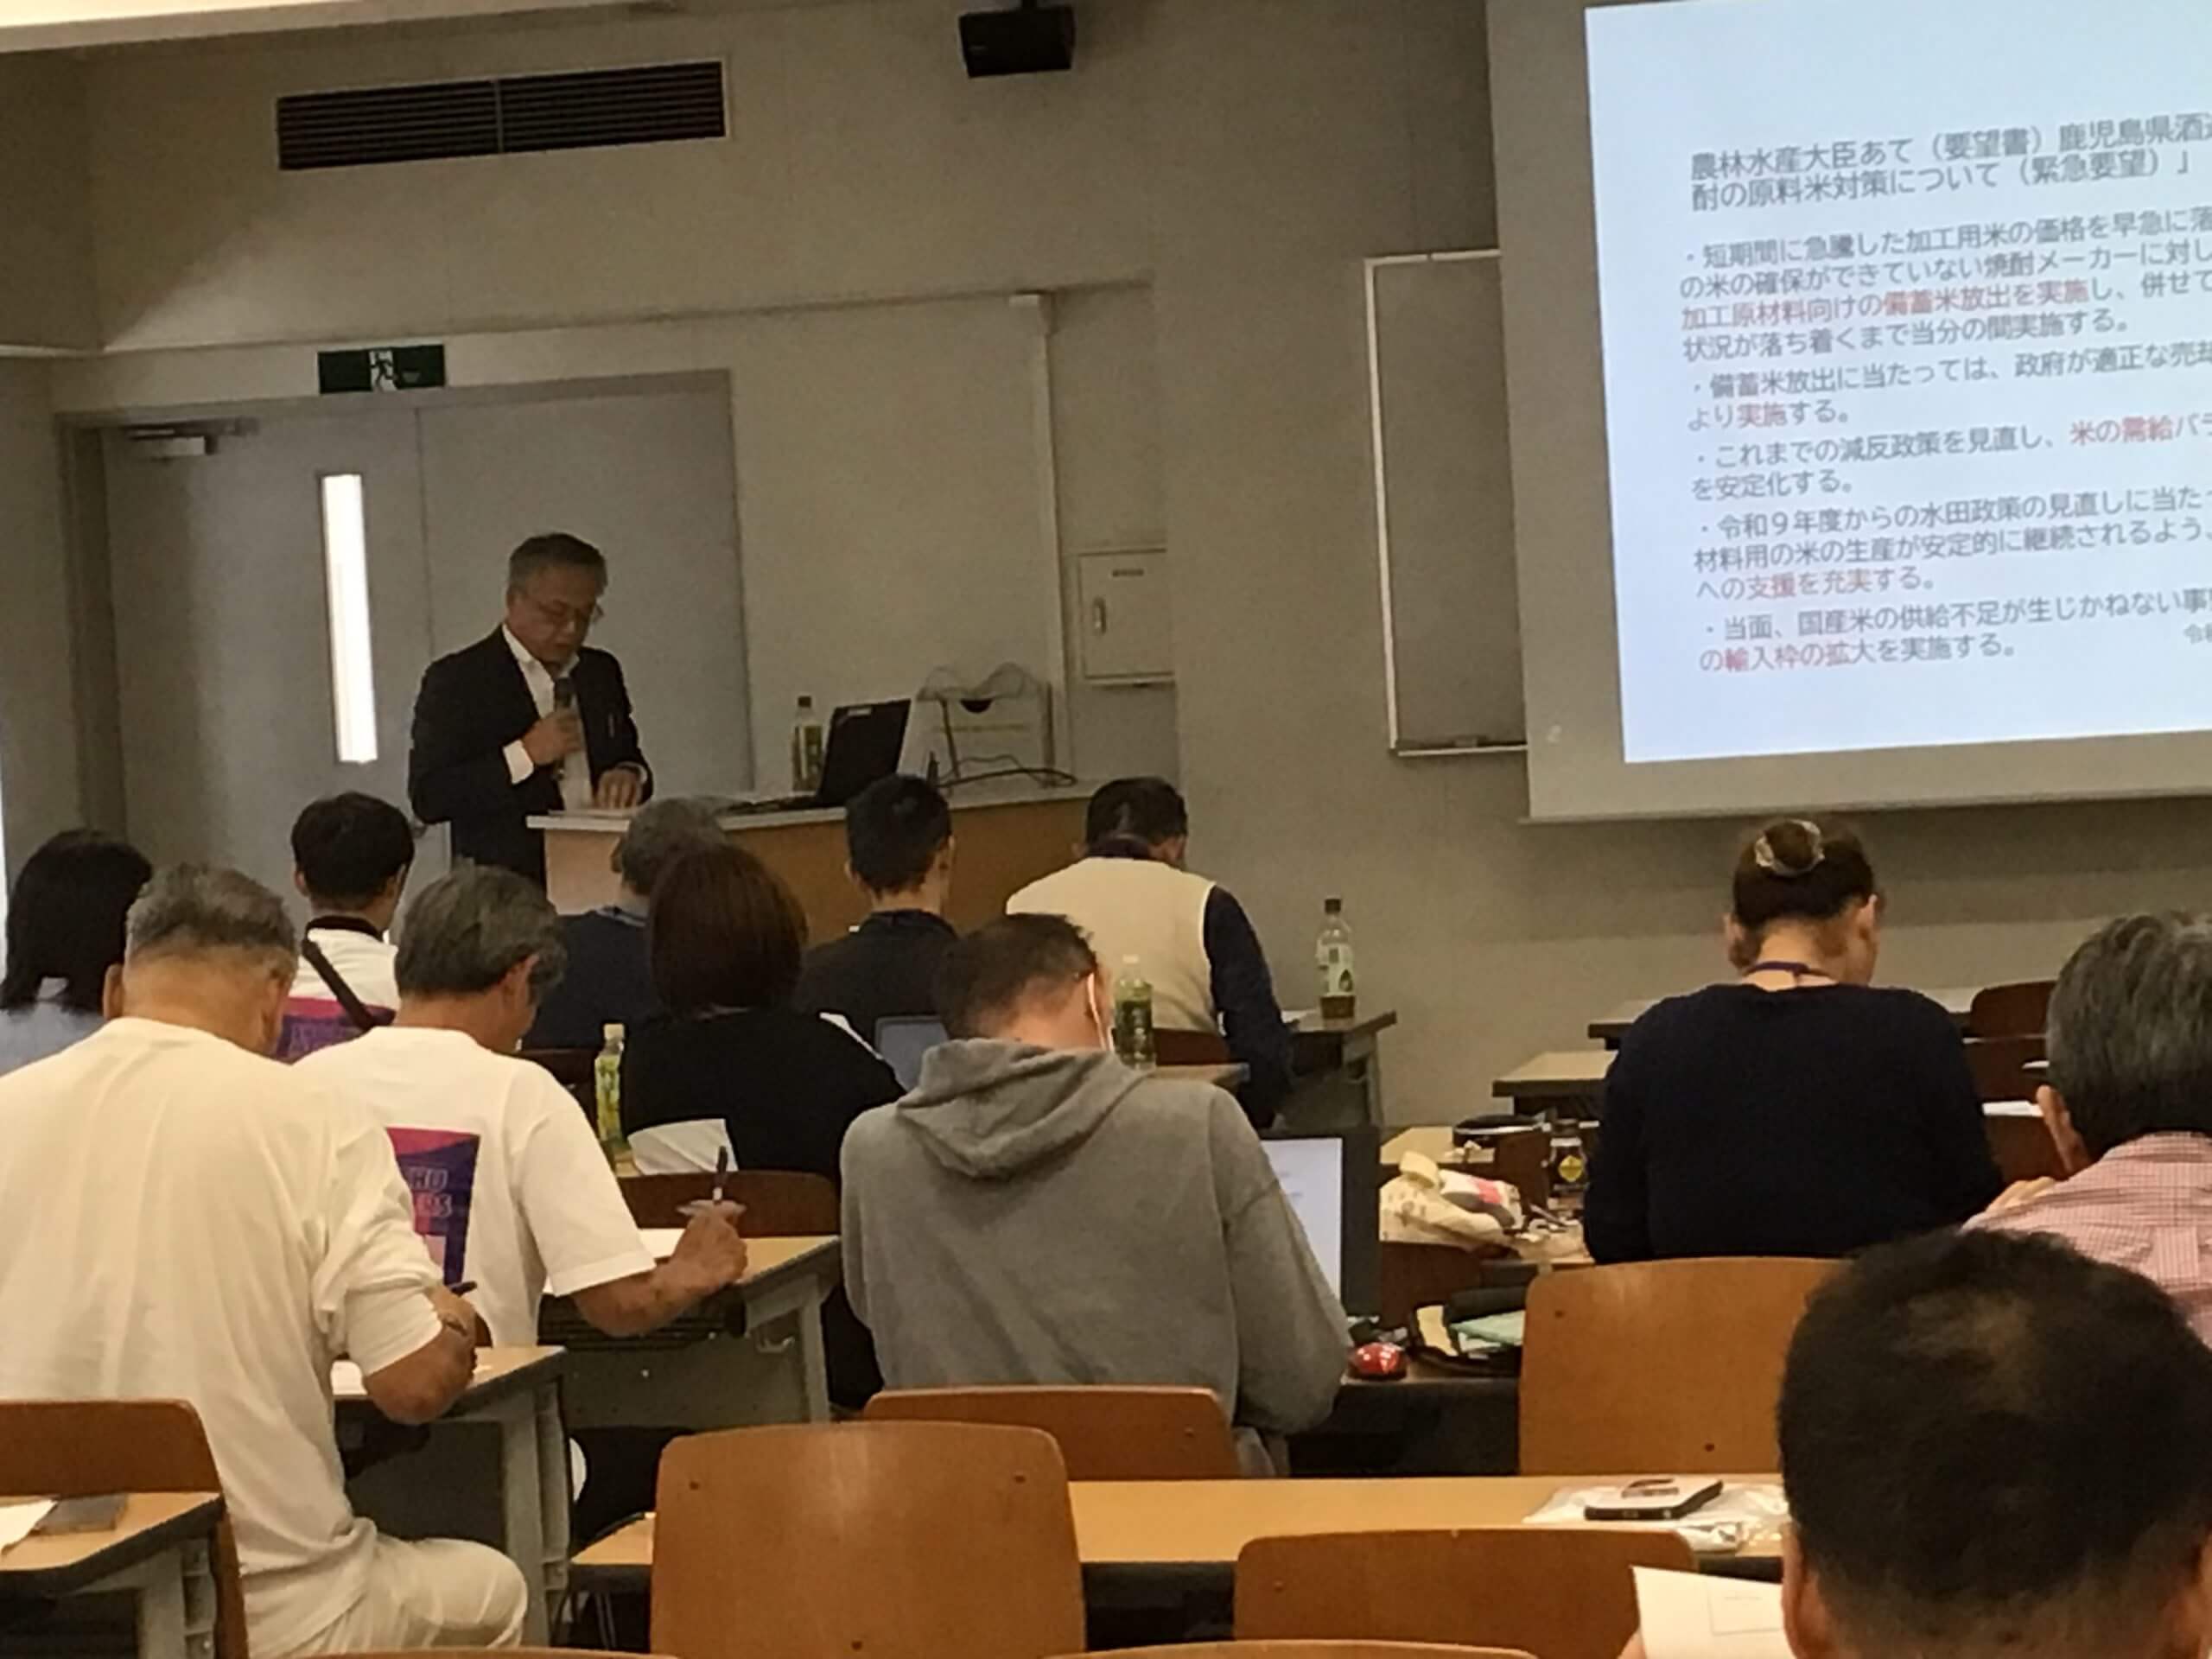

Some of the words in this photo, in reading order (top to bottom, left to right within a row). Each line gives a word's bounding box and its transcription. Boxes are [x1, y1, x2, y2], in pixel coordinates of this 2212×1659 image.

[1688, 399, 1848, 431] より実施する。
[1692, 469, 1853, 501] を安定化する。
[1697, 565, 1934, 601] への支援を充実する。
[1700, 632, 2014, 672] の輸入枠の拡大を実施する。
